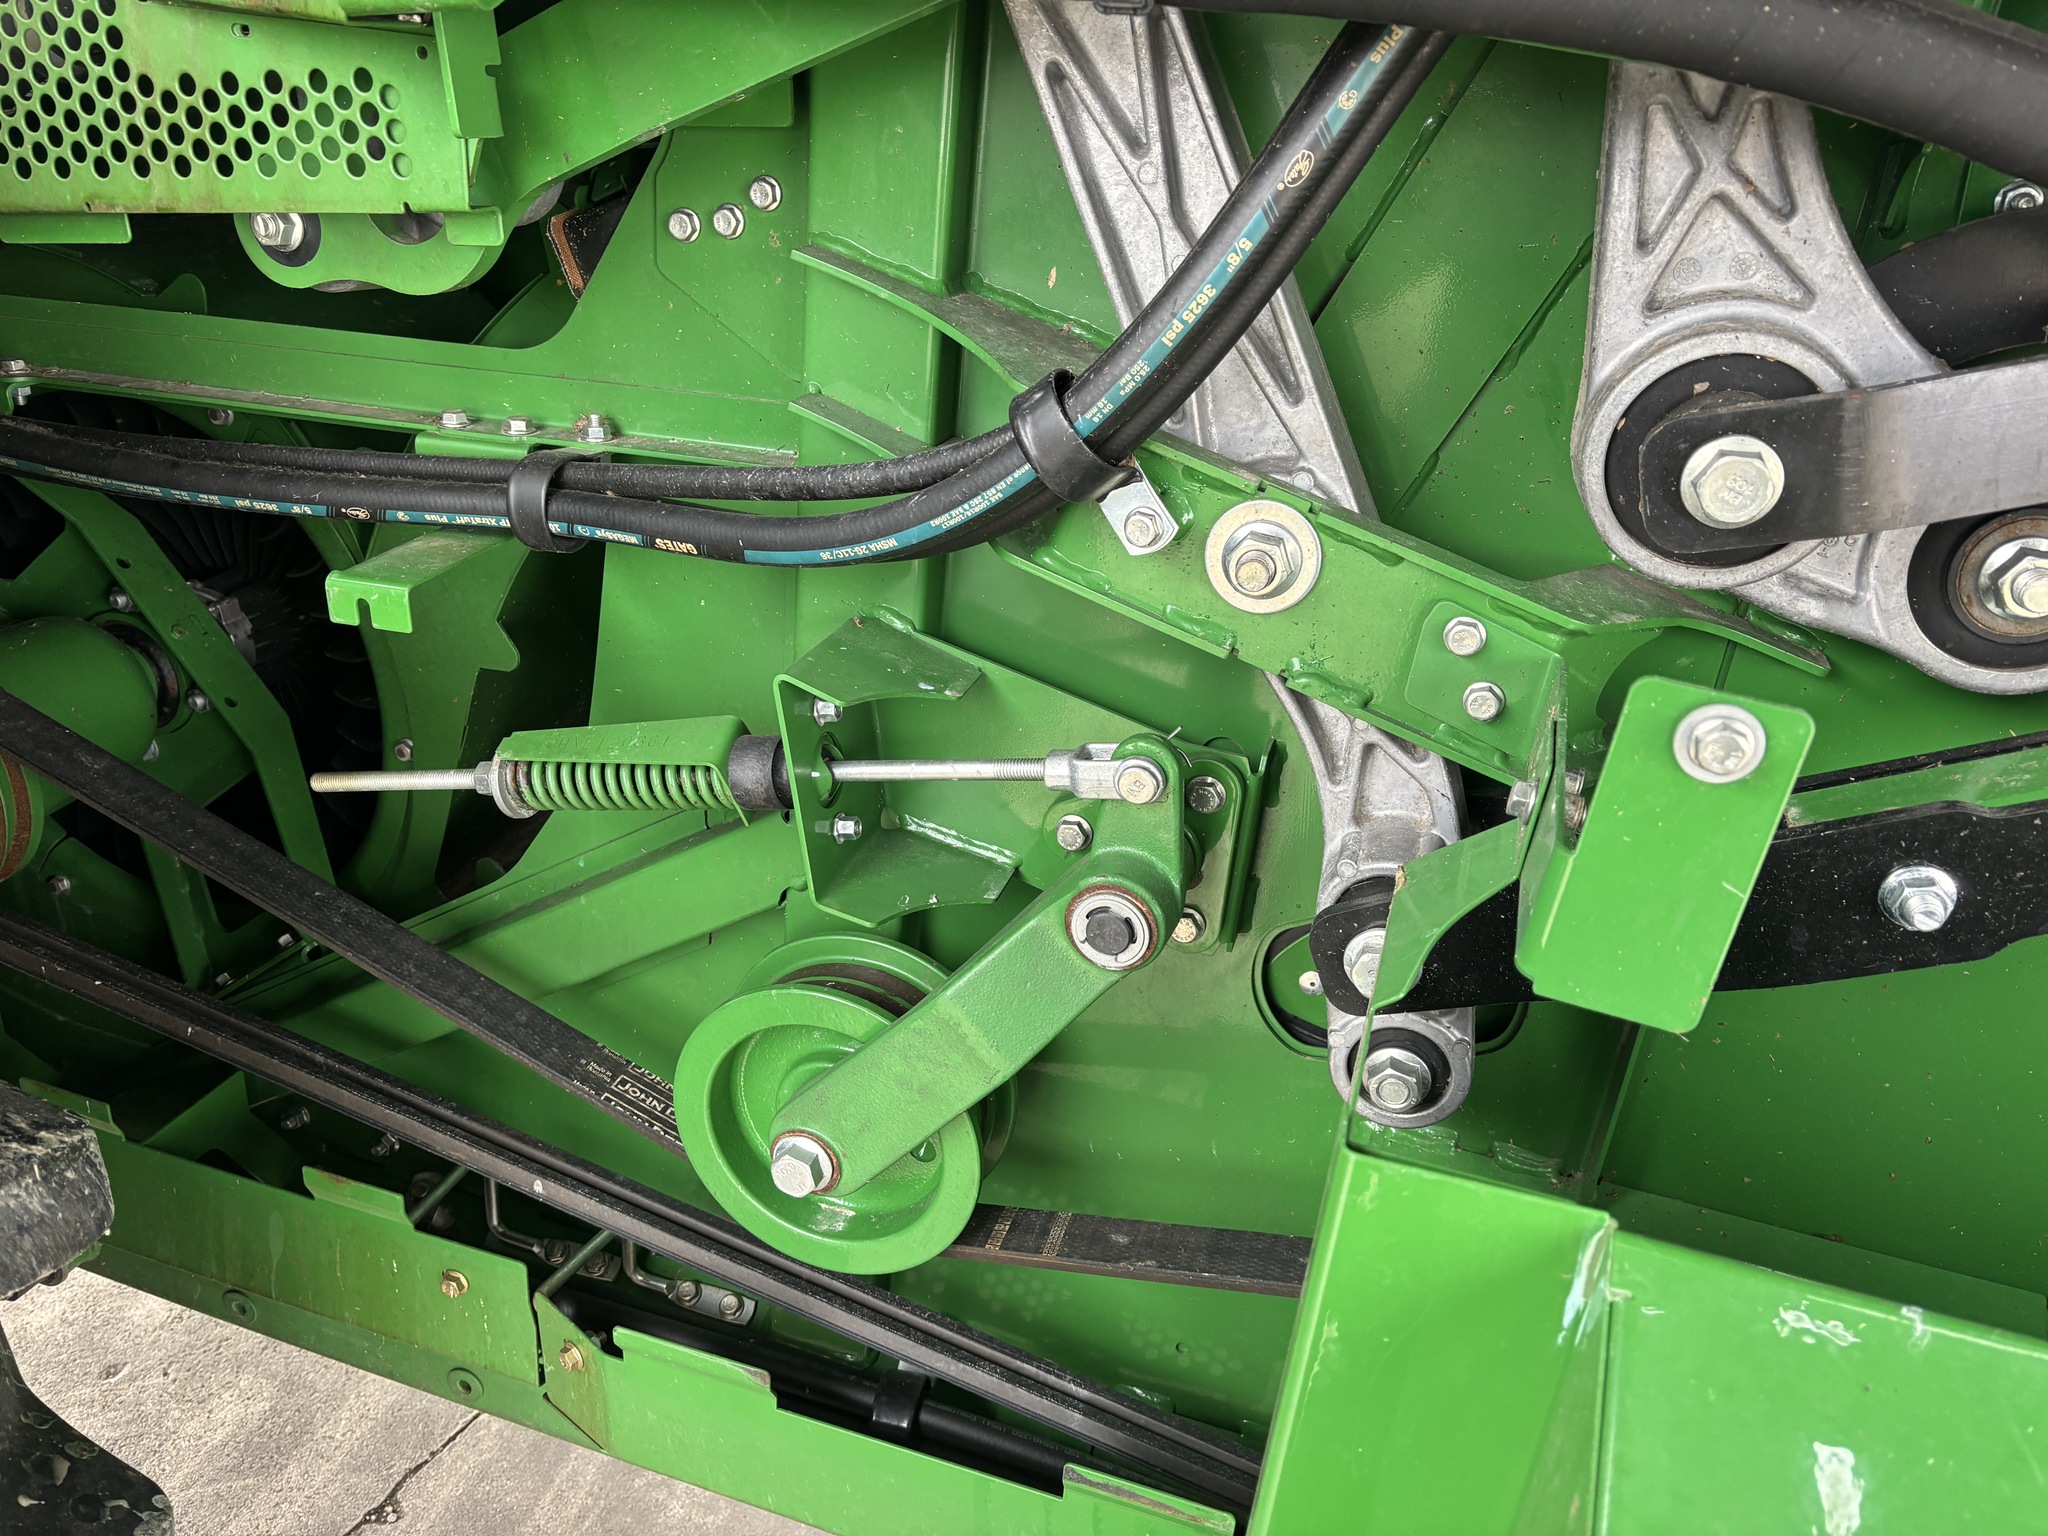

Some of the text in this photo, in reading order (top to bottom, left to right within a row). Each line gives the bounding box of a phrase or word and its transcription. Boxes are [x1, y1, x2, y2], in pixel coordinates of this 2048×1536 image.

[1368, 25, 1405, 67] Plus
[1158, 234, 1253, 347] 5/8" 3625 psi
[1119, 360, 1144, 386] 250 Bar
[1120, 365, 1150, 395] 25.0 MPa
[1085, 406, 1098, 419] mm
[1102, 403, 1113, 414] DN
[996, 482, 1006, 490] EN
[1006, 476, 1013, 484] of
[989, 492, 1003, 502] SAE
[235, 499, 312, 514] 5/8" 3625 psi
[950, 507, 964, 517] SAE
[424, 514, 448, 522] Plus
[455, 516, 498, 526] XtraTuff
[930, 514, 950, 526] 100R2
[596, 530, 638, 544] MEGASys
[655, 538, 697, 554] GATES
[820, 538, 898, 560] MSHA 2G-11C/36
[589, 1062, 606, 1072] Made
[618, 1083, 666, 1112] JOHN
